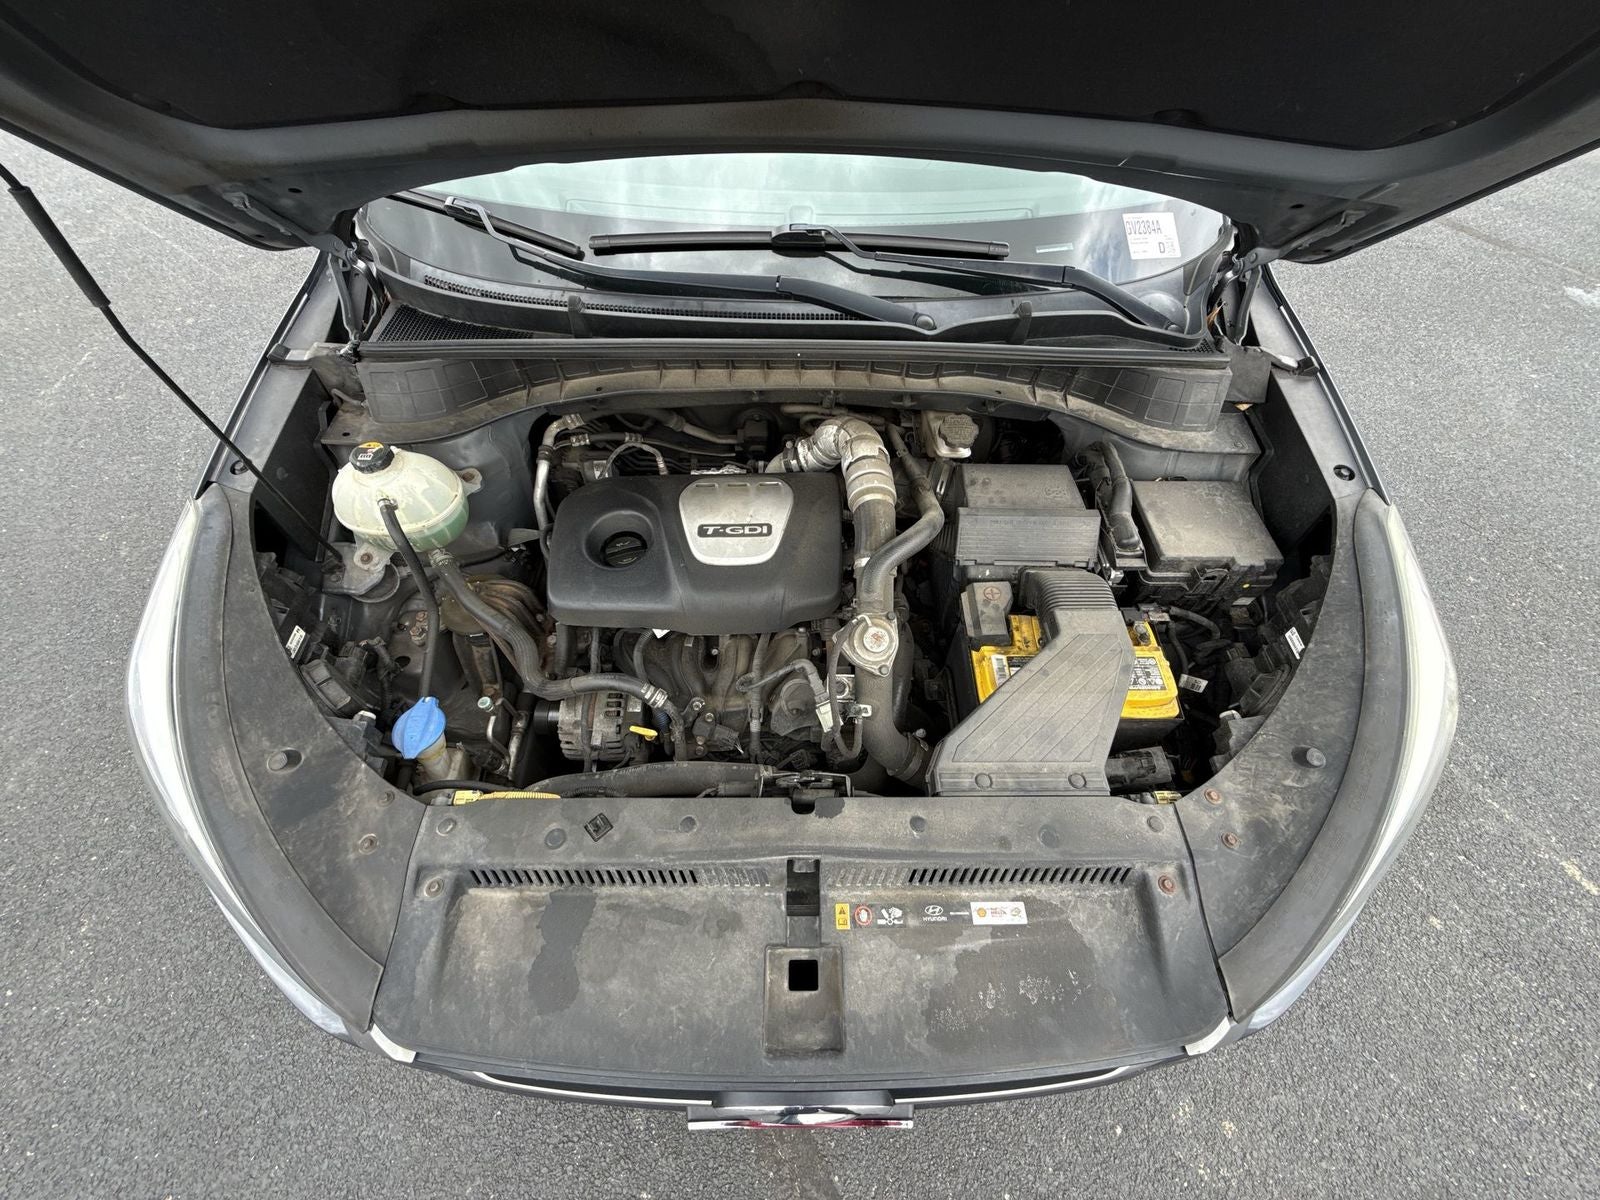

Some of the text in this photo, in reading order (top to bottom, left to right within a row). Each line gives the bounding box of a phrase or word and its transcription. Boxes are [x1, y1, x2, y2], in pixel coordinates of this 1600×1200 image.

[1125, 219, 1162, 235] GV2384A
[1158, 241, 1166, 254] D
[702, 525, 768, 535] T-GDI
